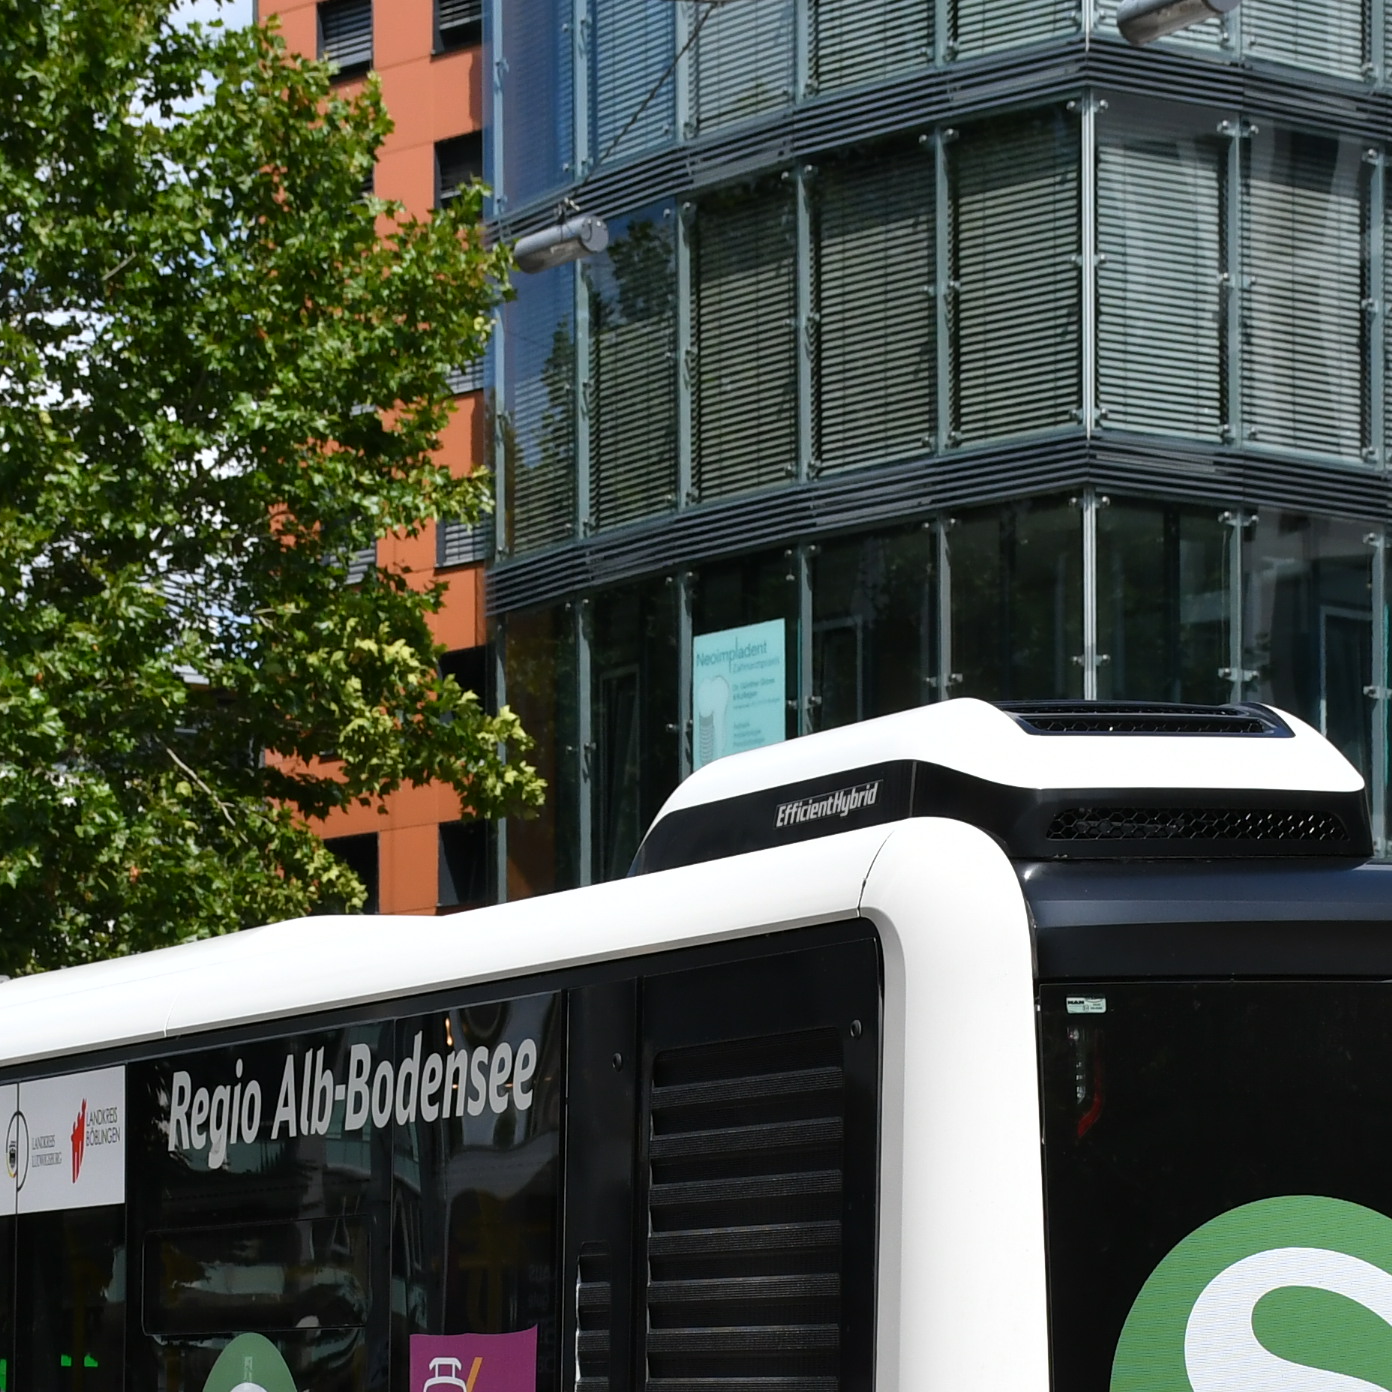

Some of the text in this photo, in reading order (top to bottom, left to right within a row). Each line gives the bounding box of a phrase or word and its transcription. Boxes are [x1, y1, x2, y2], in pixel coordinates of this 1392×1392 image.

[696, 637, 768, 673] Neoimpladent
[776, 782, 879, 828] EfficientHybrid
[168, 1030, 537, 1169] Regio Alb-Bodensee
